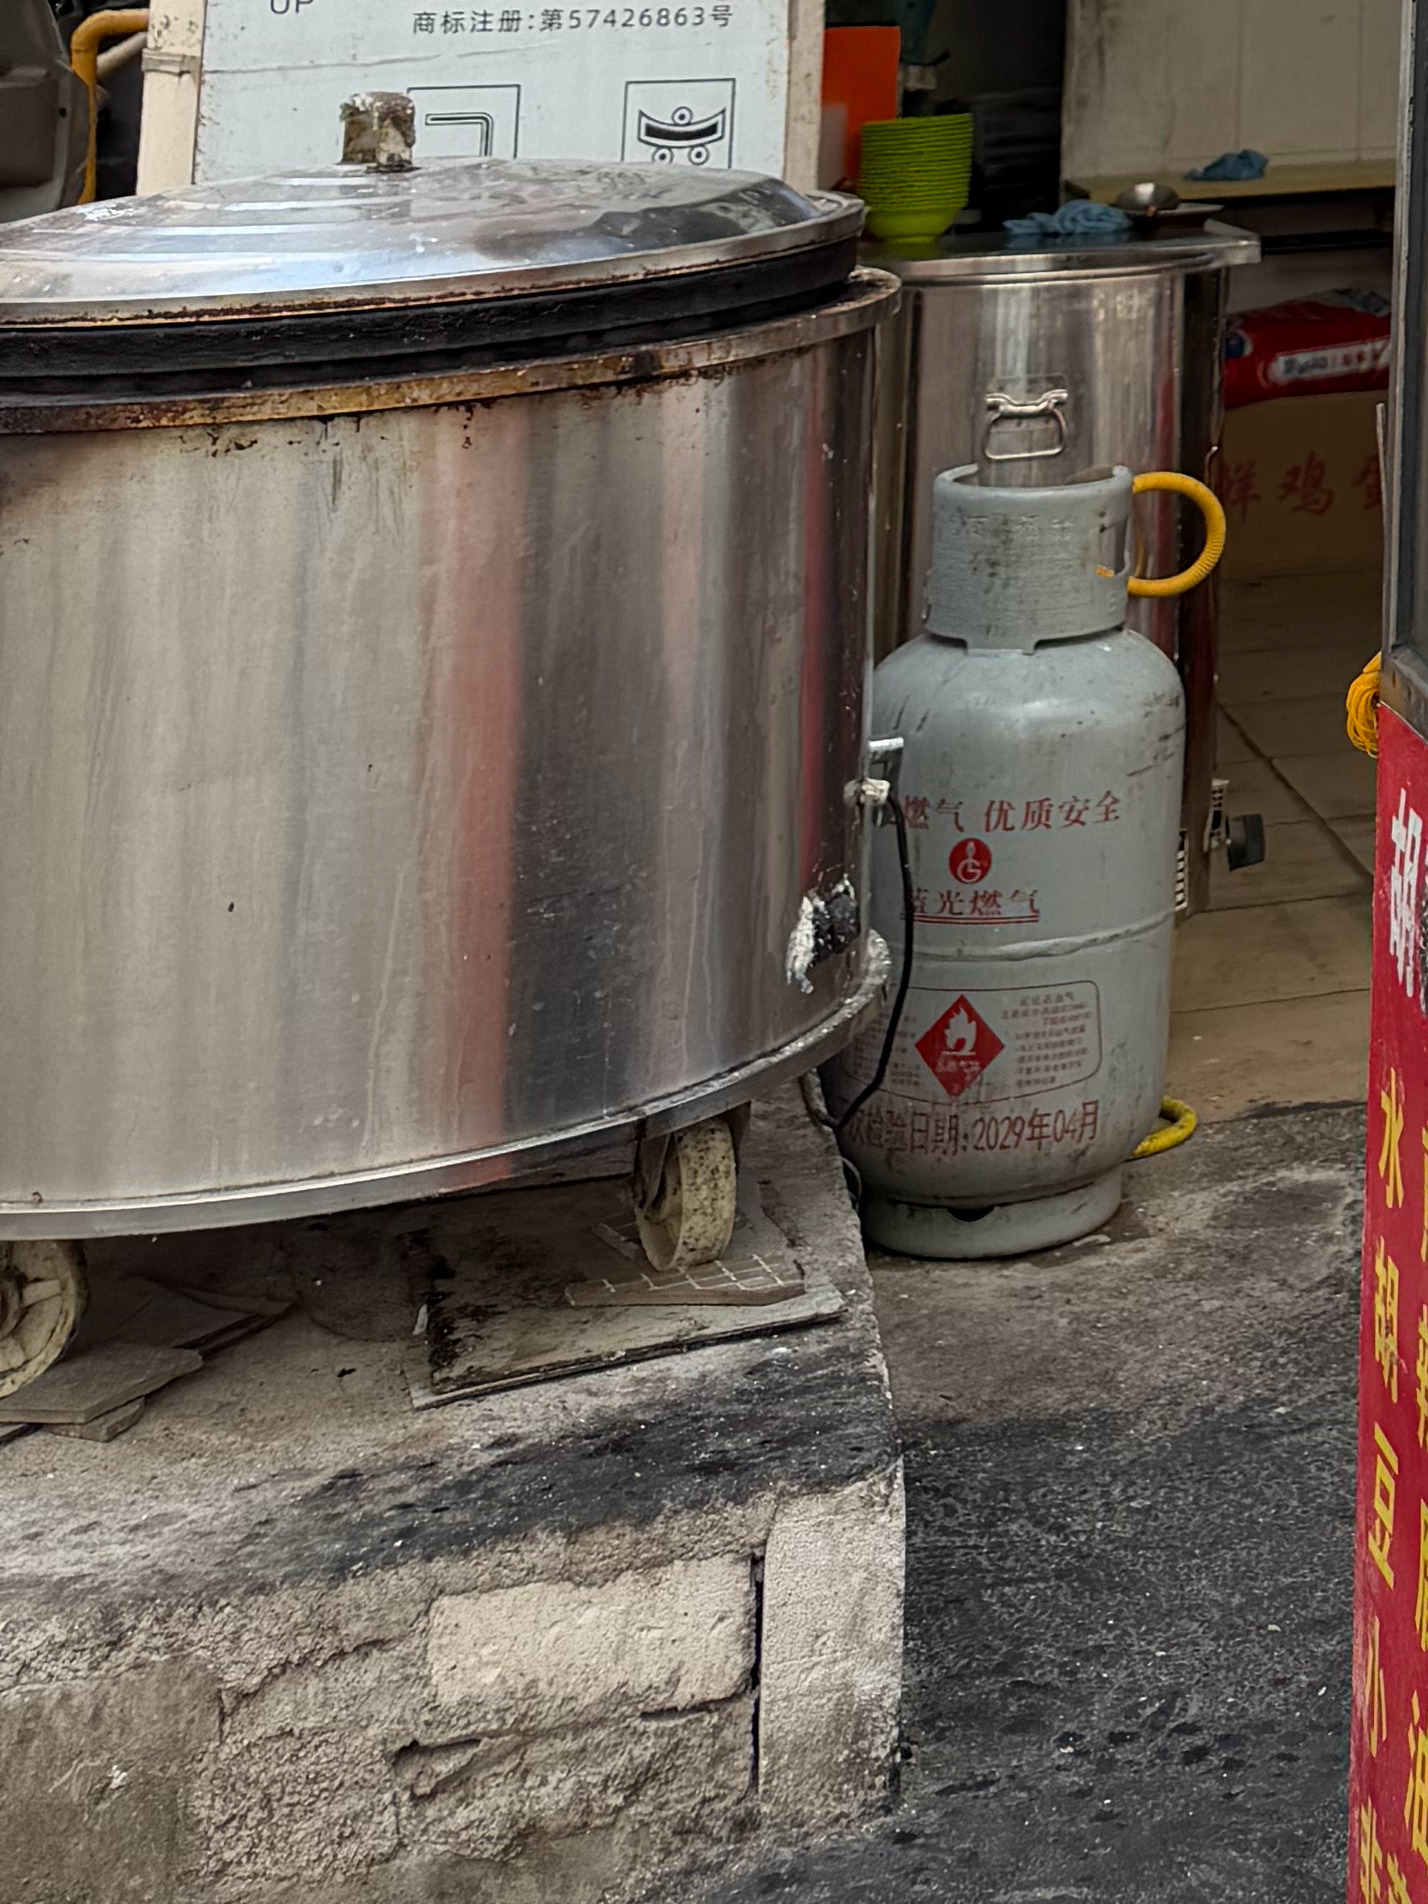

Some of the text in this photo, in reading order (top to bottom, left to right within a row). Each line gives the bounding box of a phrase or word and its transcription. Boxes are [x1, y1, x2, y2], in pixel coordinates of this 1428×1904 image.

[412, 5, 734, 35] 商标注册:第57426863号
[887, 790, 1121, 833] 燃气 优质安全
